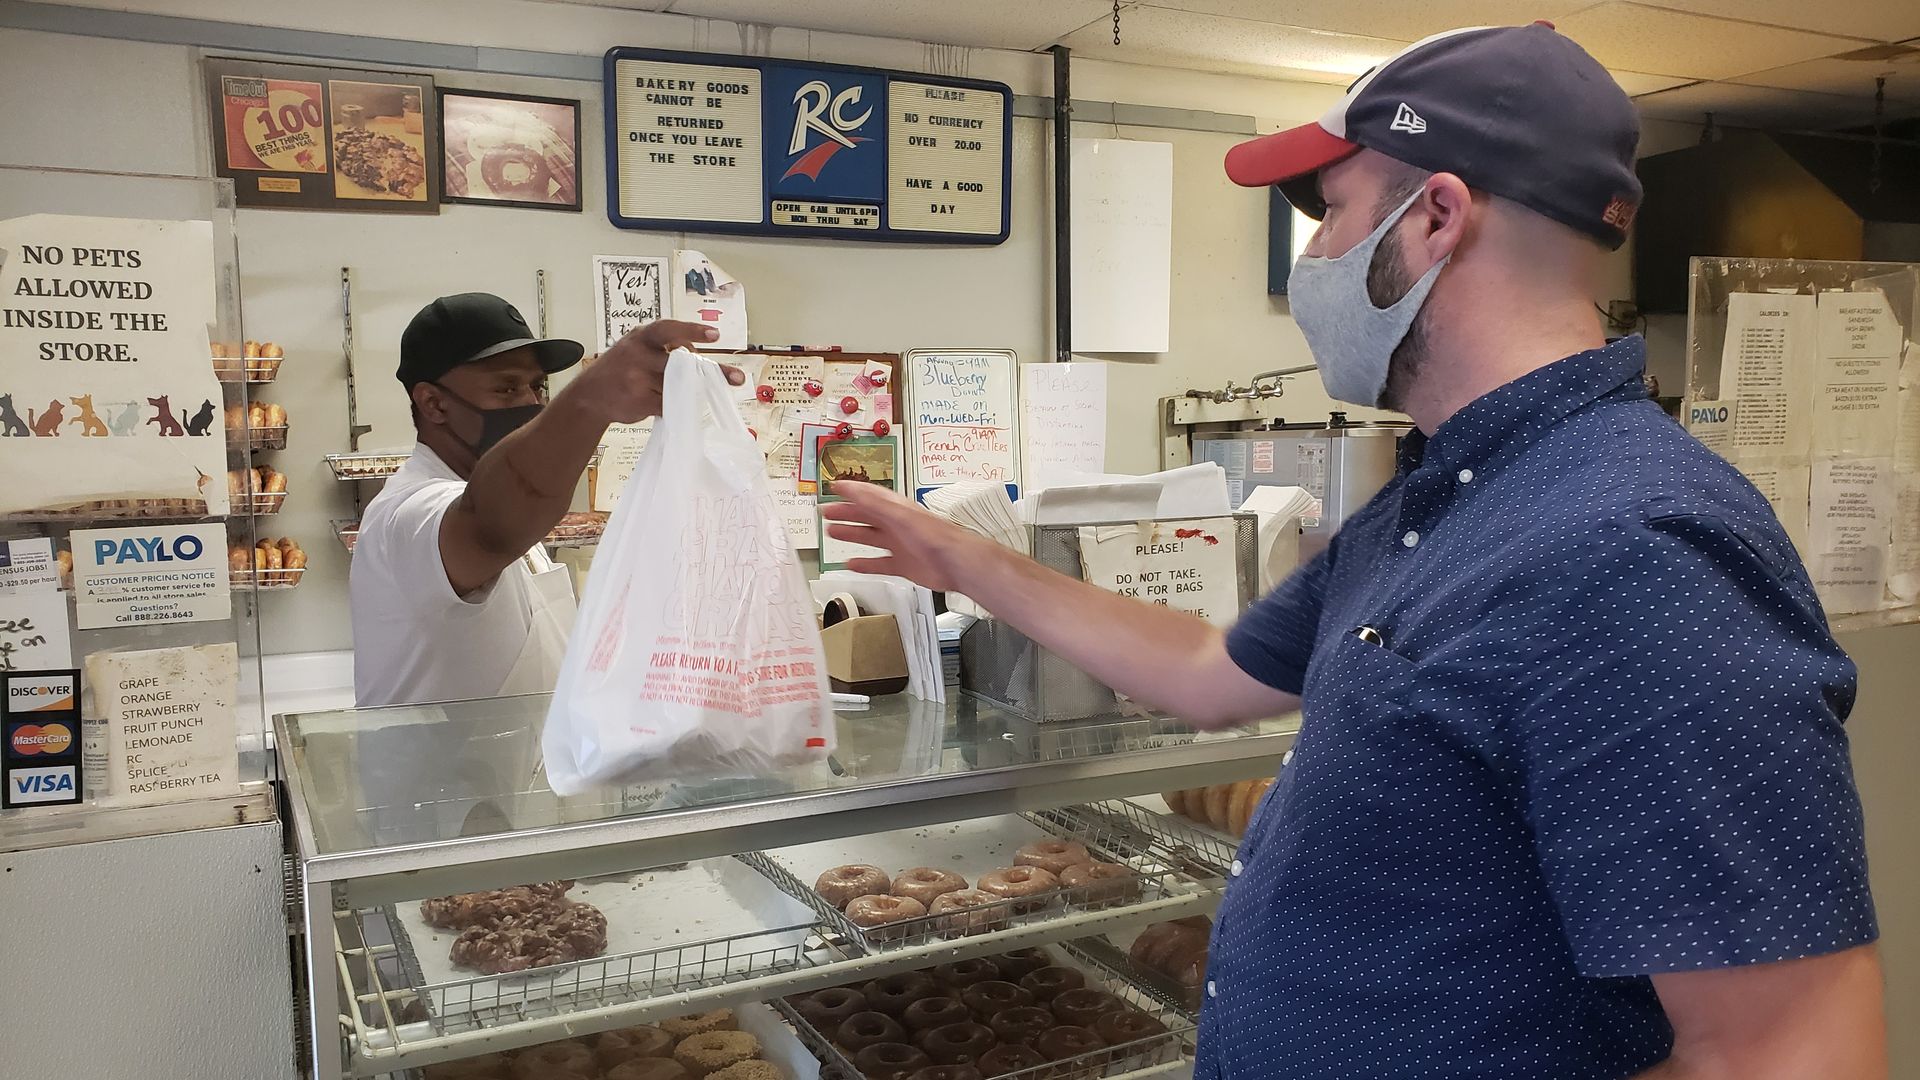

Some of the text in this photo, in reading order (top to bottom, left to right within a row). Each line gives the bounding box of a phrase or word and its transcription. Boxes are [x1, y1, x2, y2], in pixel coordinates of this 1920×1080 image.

[636, 77, 749, 94] BAKERY GOODS
[646, 94, 722, 108] CANNOT BE
[925, 88, 965, 101] PLEASE
[257, 99, 322, 140] 100
[658, 116, 723, 129] RETURNED
[788, 80, 873, 156] RC
[904, 113, 983, 129] NO CURRENCY
[255, 131, 310, 153] BEST THINGS
[629, 132, 743, 148] ONCE YOU LEAVE
[909, 136, 981, 151] OVER 20.00
[282, 144, 296, 153] THIS
[649, 153, 736, 166] THE STORE
[906, 178, 983, 193] HAVE A GOOD
[776, 204, 800, 212] OPEN
[836, 207, 858, 215] UNTIL
[931, 204, 955, 214] DAY
[791, 215, 807, 223] MON
[854, 218, 868, 226] SAT
[22, 245, 142, 268] NO PETS
[616, 265, 650, 290] Yes!
[14, 277, 153, 300] ALLOWED
[624, 292, 642, 307] We
[3, 309, 168, 331] INSIDE THE
[612, 307, 653, 323] accept
[39, 342, 138, 362] STORE.
[1691, 407, 1728, 424] PAYLO
[95, 535, 203, 566] PAYLO
[1136, 542, 1184, 555] PLEASE!
[26, 564, 47, 572] JOBS!
[86, 572, 215, 587] CUSTOMER PRICING NOTICE
[1116, 569, 1201, 584] DO NOT TAKE.
[131, 585, 170, 593] customer
[1118, 582, 1203, 597] ASK FOR BAGS
[130, 603, 178, 612] Questions?
[135, 611, 193, 621] 888.226.8643
[650, 652, 676, 667] PLEASE
[679, 653, 711, 671] RETURN
[714, 656, 725, 673] TO
[11, 686, 70, 696] DISCOVER
[119, 677, 159, 690] GRAPE
[121, 691, 172, 705] ORANGE
[122, 702, 201, 720] STRAWBERRY
[124, 717, 203, 734] FRUIT PUNCH
[13, 735, 69, 745] MasterCard
[125, 733, 193, 749] LEMONADE
[127, 754, 142, 764] RC
[128, 766, 167, 779] SPLICE
[199, 773, 221, 784] TEA
[13, 774, 73, 793] VISA
